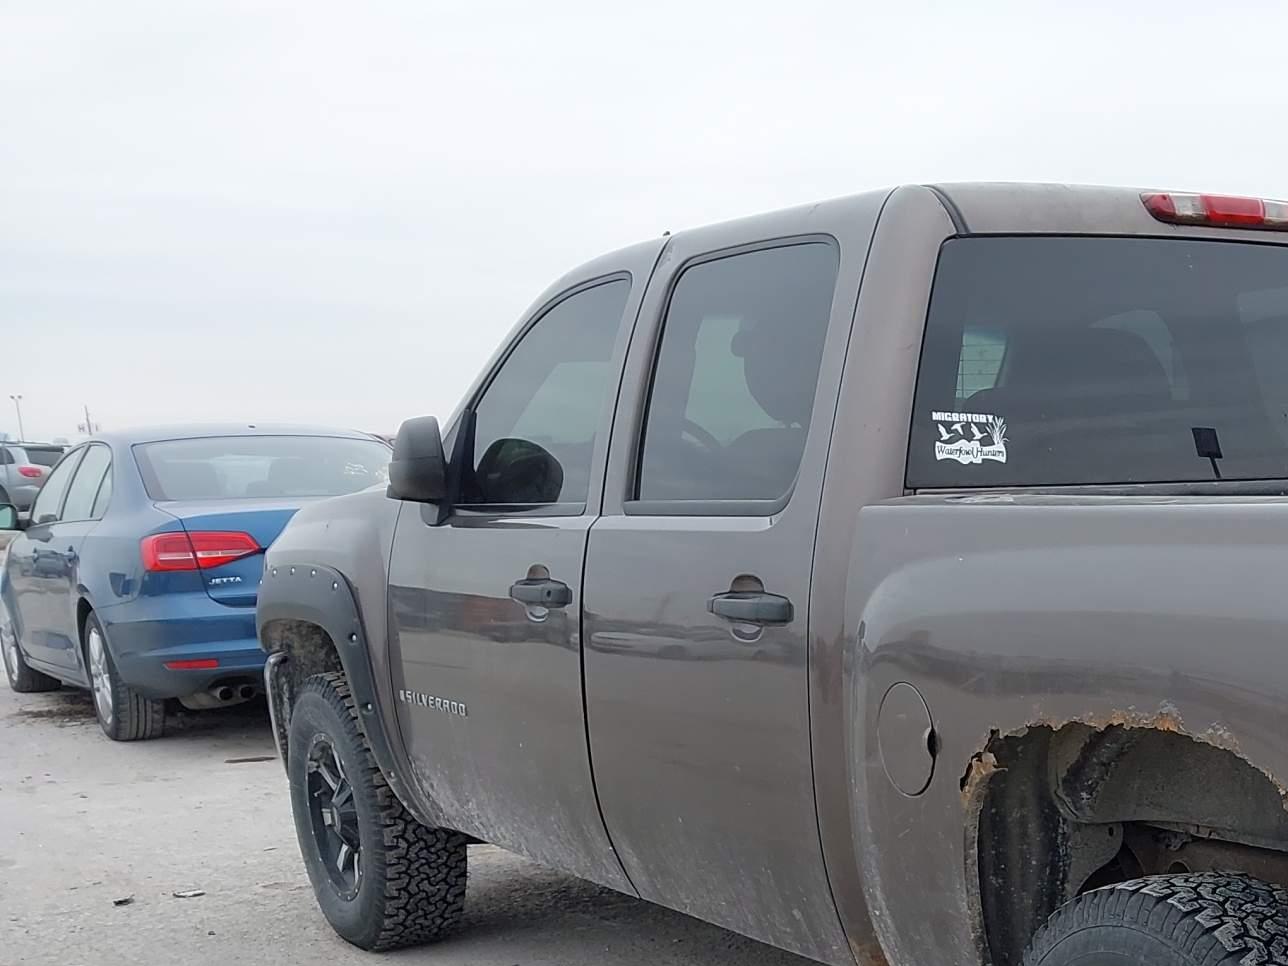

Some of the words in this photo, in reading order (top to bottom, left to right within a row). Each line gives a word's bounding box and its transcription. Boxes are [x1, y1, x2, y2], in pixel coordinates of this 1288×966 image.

[931, 411, 994, 423] MIGRATORY
[208, 576, 242, 585] JETTA
[405, 690, 467, 717] SILVERADO
